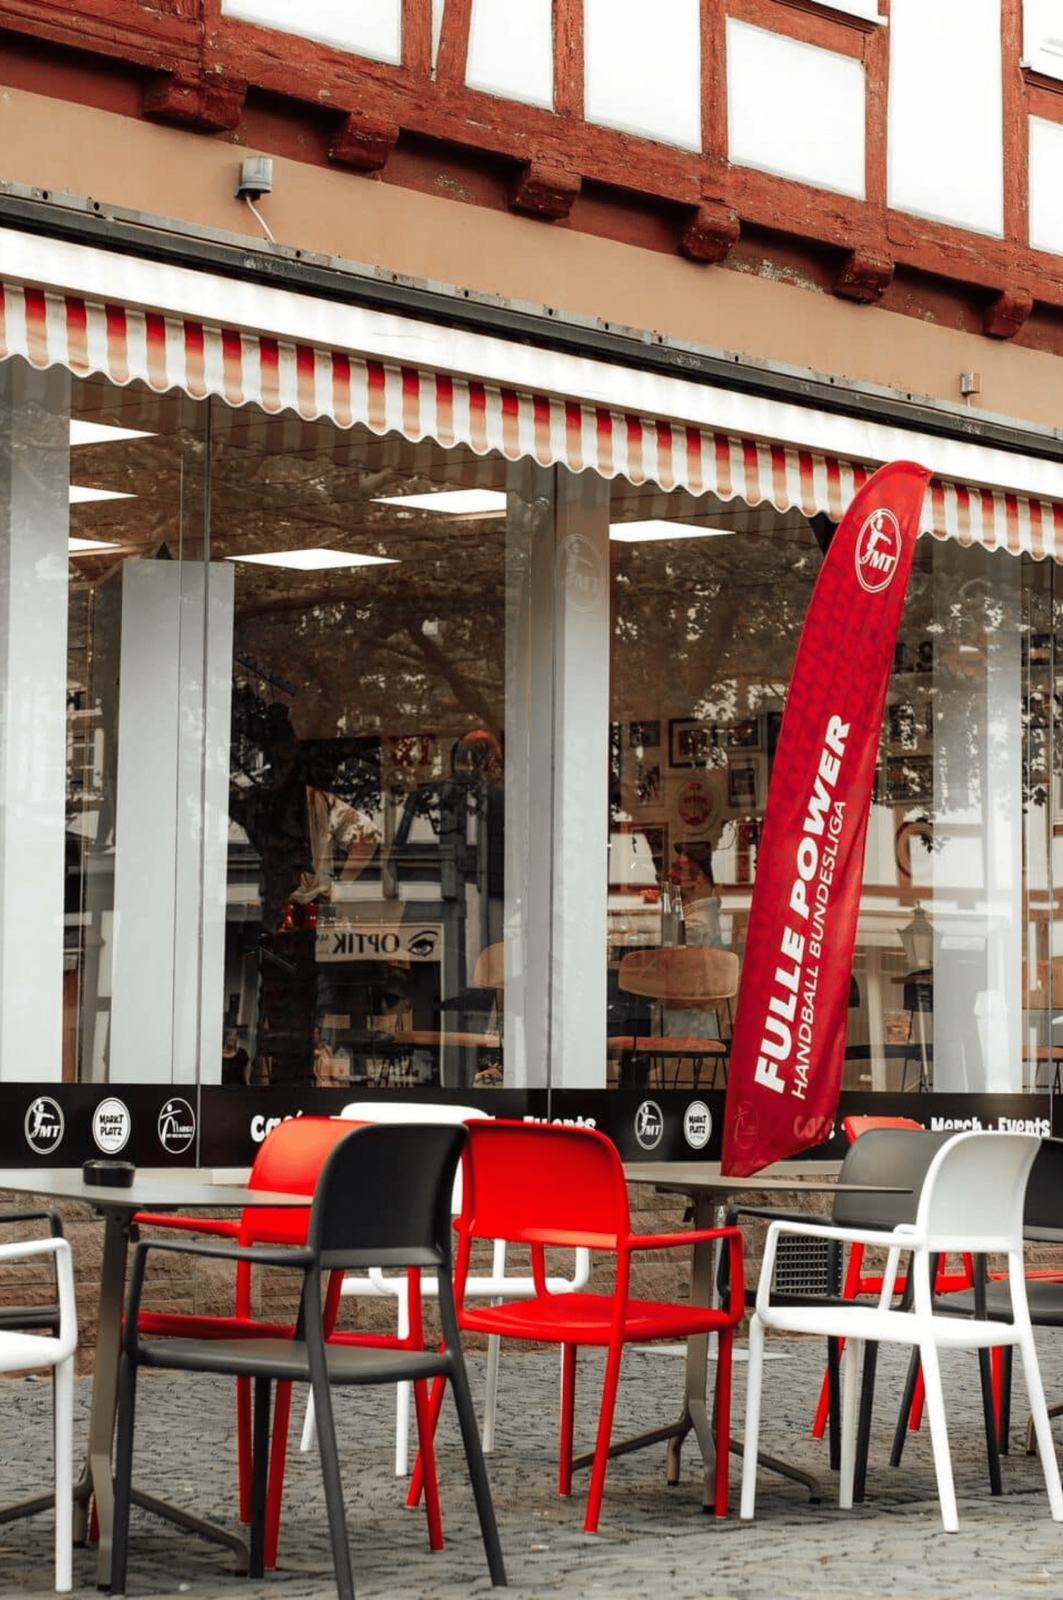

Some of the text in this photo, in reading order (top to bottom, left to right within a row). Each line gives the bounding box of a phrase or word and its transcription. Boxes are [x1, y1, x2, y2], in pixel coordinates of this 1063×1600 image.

[868, 549, 896, 573] MT
[754, 714, 851, 1094] FULLE POWER
[791, 801, 847, 1101] HANDBALL BUNDESLIGA
[99, 1113, 124, 1126] MARKT
[997, 1116, 1051, 1137] Events
[38, 1124, 61, 1138] MT
[100, 1126, 123, 1137] PLATZ
[645, 1125, 661, 1136] MT
